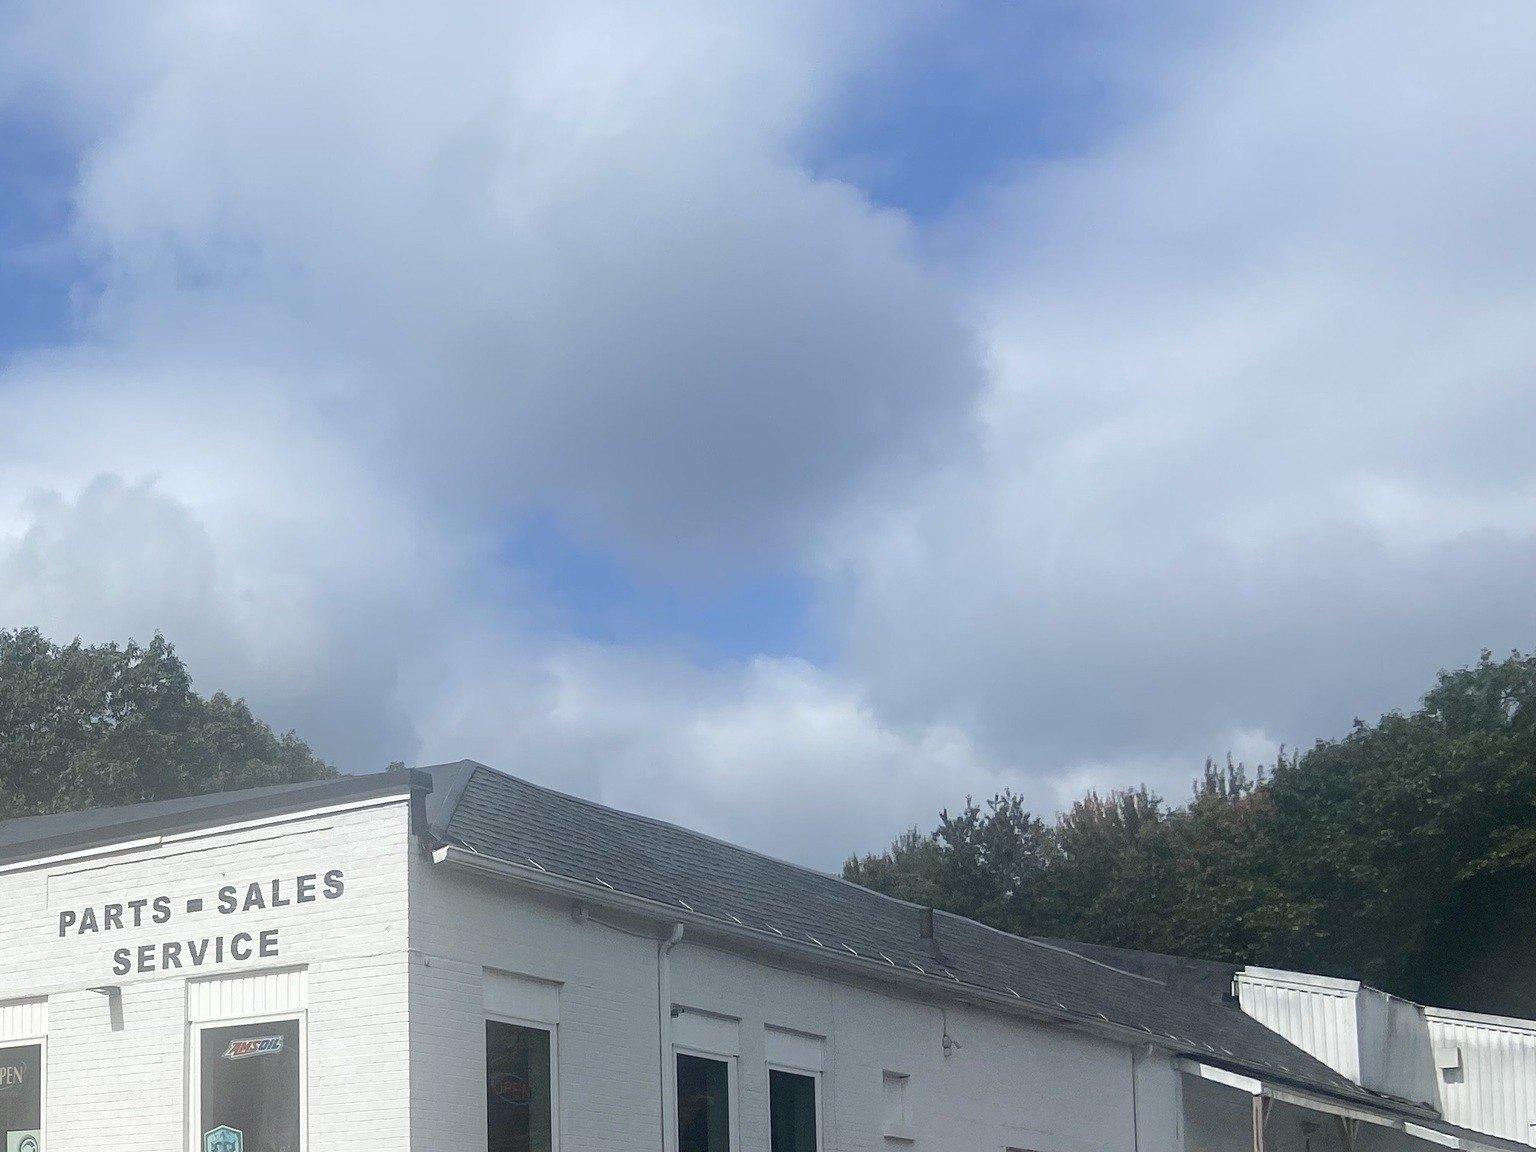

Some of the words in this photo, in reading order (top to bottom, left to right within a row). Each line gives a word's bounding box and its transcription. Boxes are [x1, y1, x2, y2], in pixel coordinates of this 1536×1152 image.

[59, 896, 172, 937] PARTS
[217, 869, 345, 915] SALES
[112, 929, 279, 976] SERVICE
[227, 1037, 282, 1056] AMSOIL
